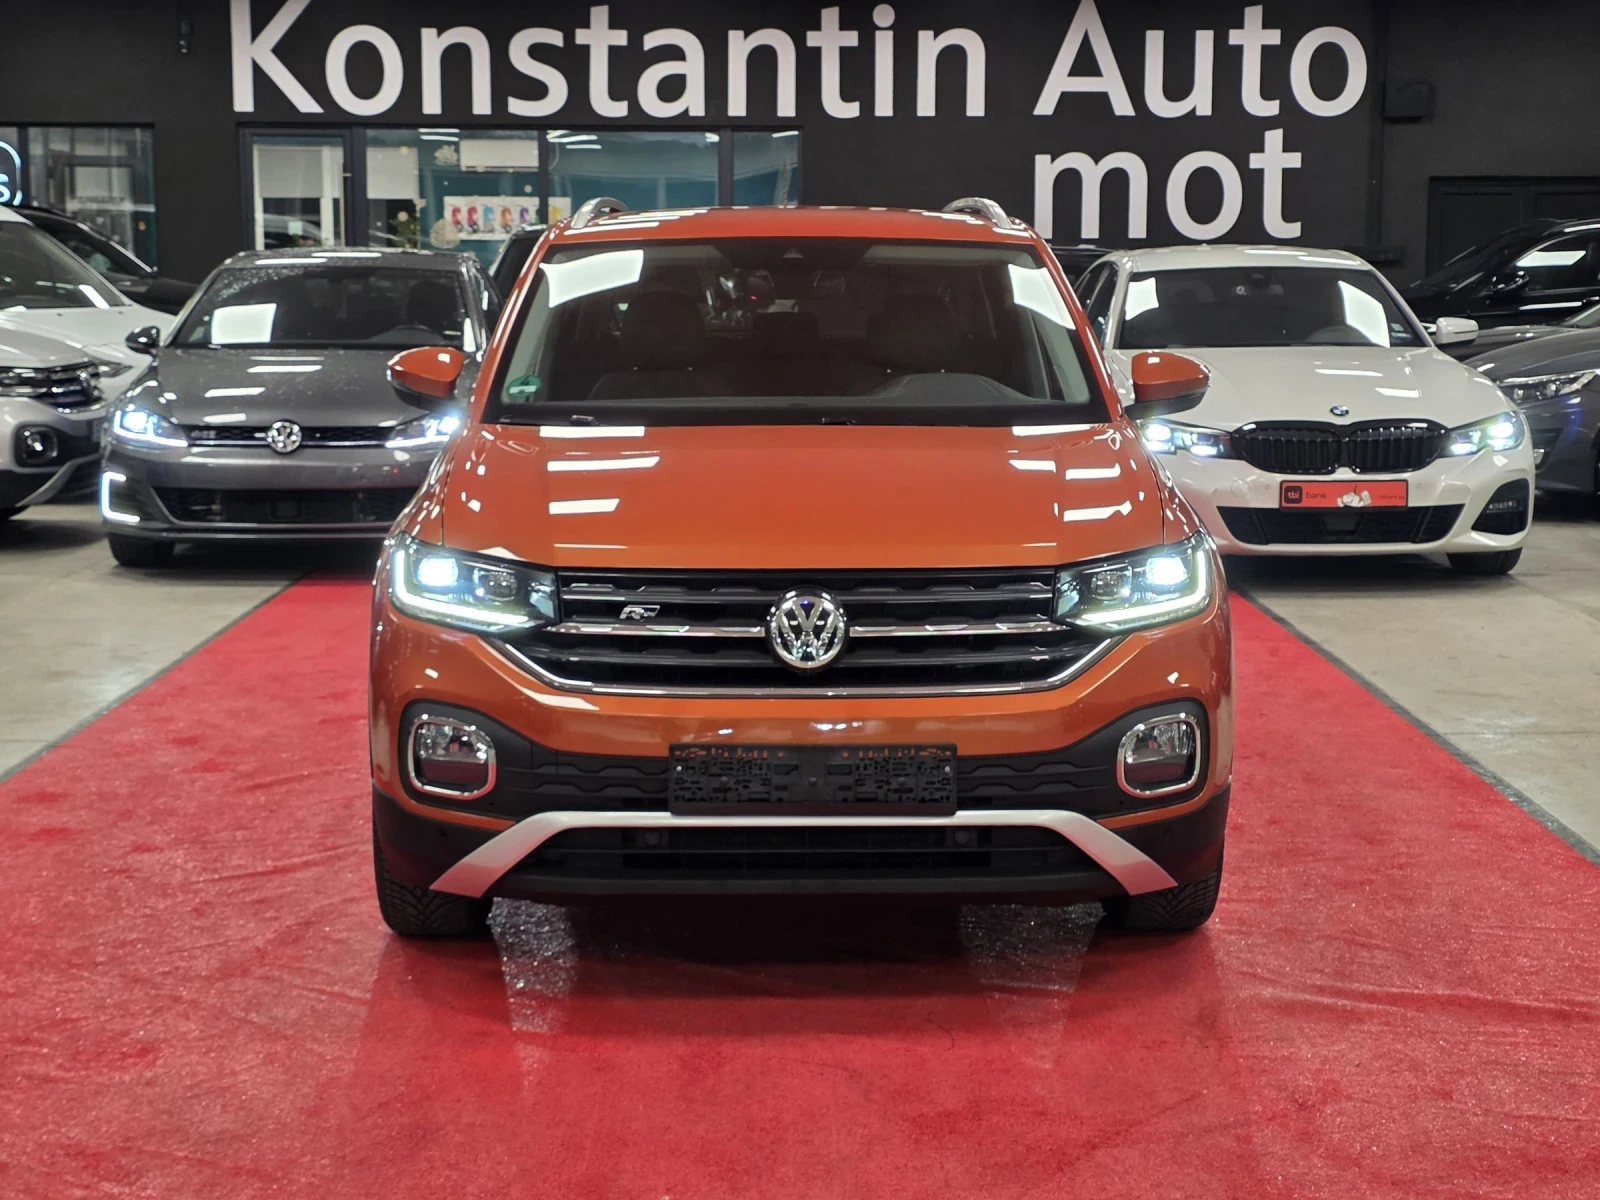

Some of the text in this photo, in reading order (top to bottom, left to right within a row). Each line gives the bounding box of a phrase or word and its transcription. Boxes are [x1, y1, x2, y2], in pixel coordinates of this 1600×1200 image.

[230, 0, 1367, 118] Konstantin Auto
[1034, 129, 1302, 240] mot
[1287, 490, 1327, 499] tbi bank
